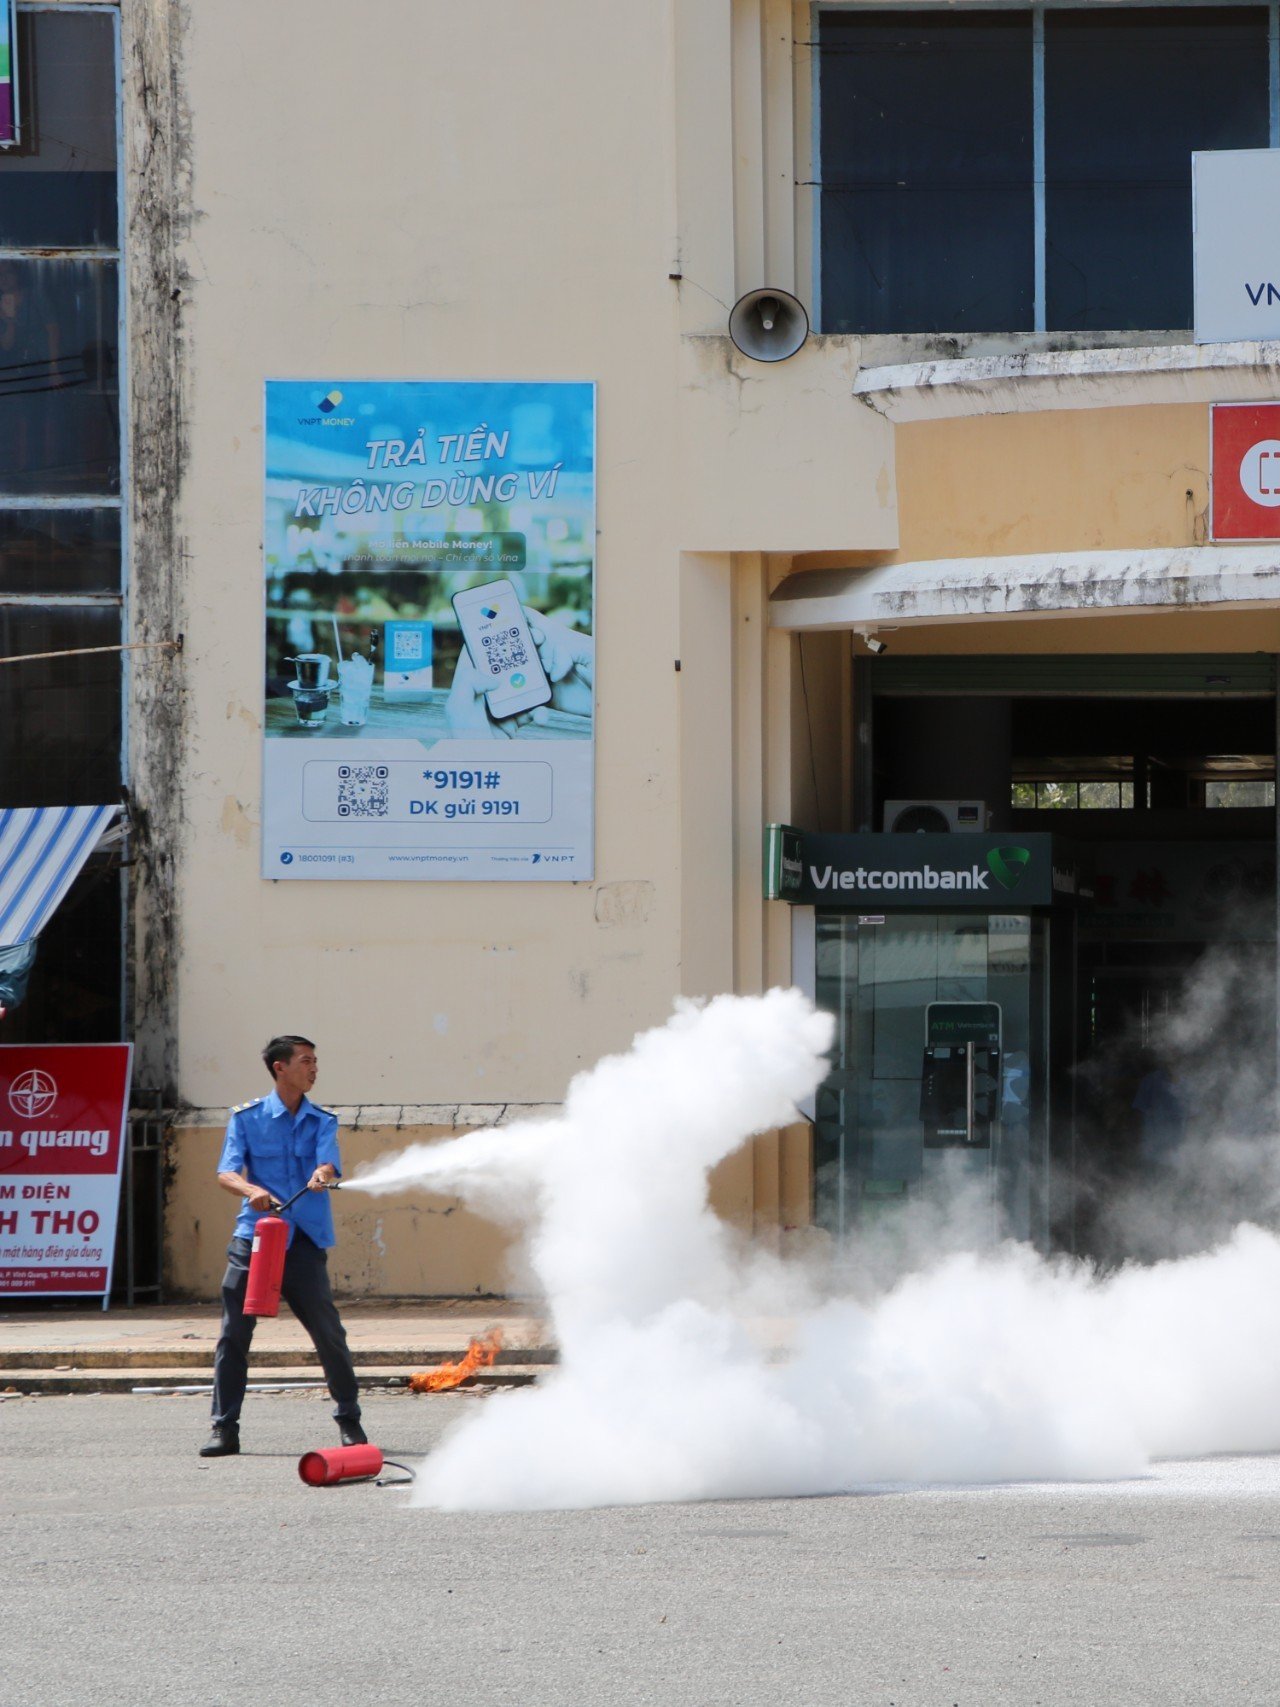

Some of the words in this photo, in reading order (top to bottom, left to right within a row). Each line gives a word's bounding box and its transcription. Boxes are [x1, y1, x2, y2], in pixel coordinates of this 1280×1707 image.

[365, 427, 427, 469] TRẢ
[438, 422, 510, 464] TIỀN
[294, 478, 416, 518] KHÔNG
[421, 470, 519, 508] DÙNG
[528, 462, 563, 500] VÍ
[412, 540, 449, 549] Mobile
[452, 540, 492, 551] Money!
[410, 800, 438, 814] DK
[444, 798, 475, 818] gửi
[482, 801, 519, 815] 9191
[388, 855, 469, 863] www.vnptmoney.vn
[809, 865, 989, 890] Vietcombank
[20, 1130, 110, 1156] quang
[22, 1182, 70, 1203] ĐIỆN
[30, 1210, 99, 1241] THỌ
[65, 1246, 79, 1261] gia
